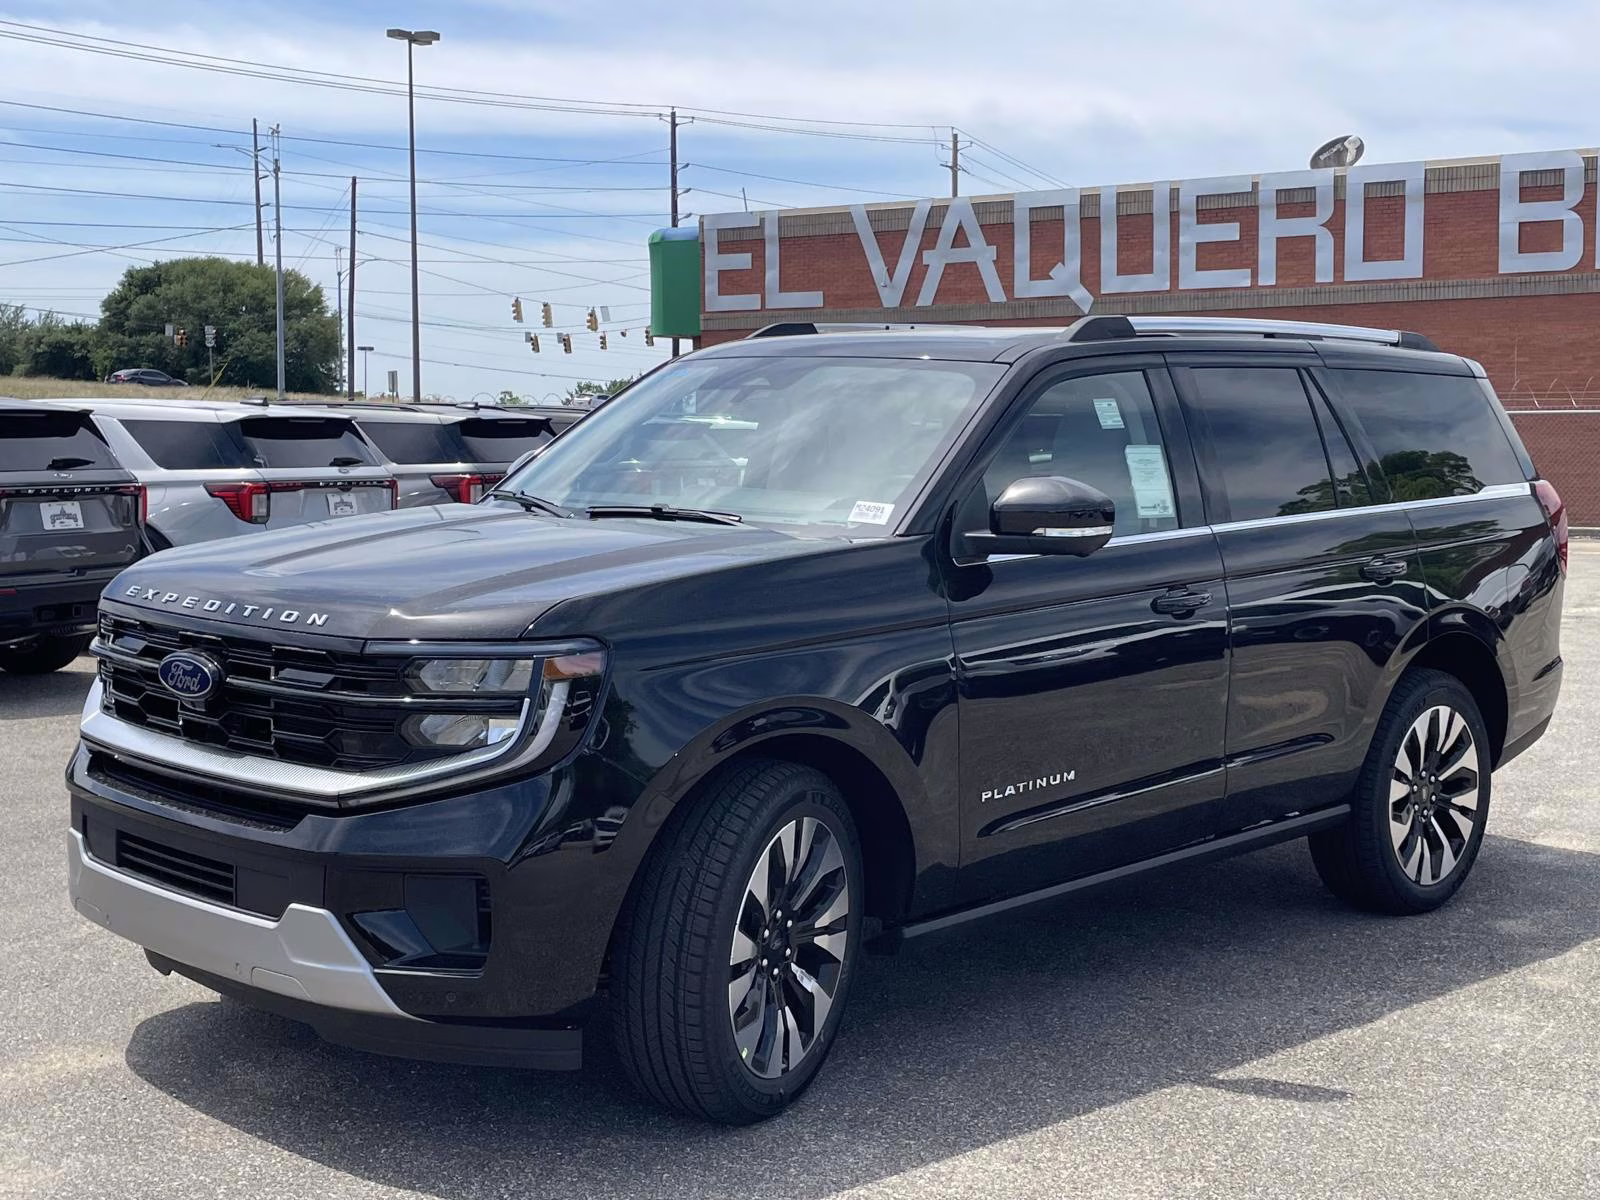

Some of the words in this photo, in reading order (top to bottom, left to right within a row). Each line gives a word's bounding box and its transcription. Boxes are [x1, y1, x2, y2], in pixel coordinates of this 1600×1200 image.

[705, 210, 823, 312] EL
[849, 160, 1426, 315] VAQUERO
[1498, 147, 1600, 274] B
[125, 585, 330, 627] EXPEDITION
[167, 660, 202, 692] Ford
[981, 770, 1076, 803] PLATINUM
